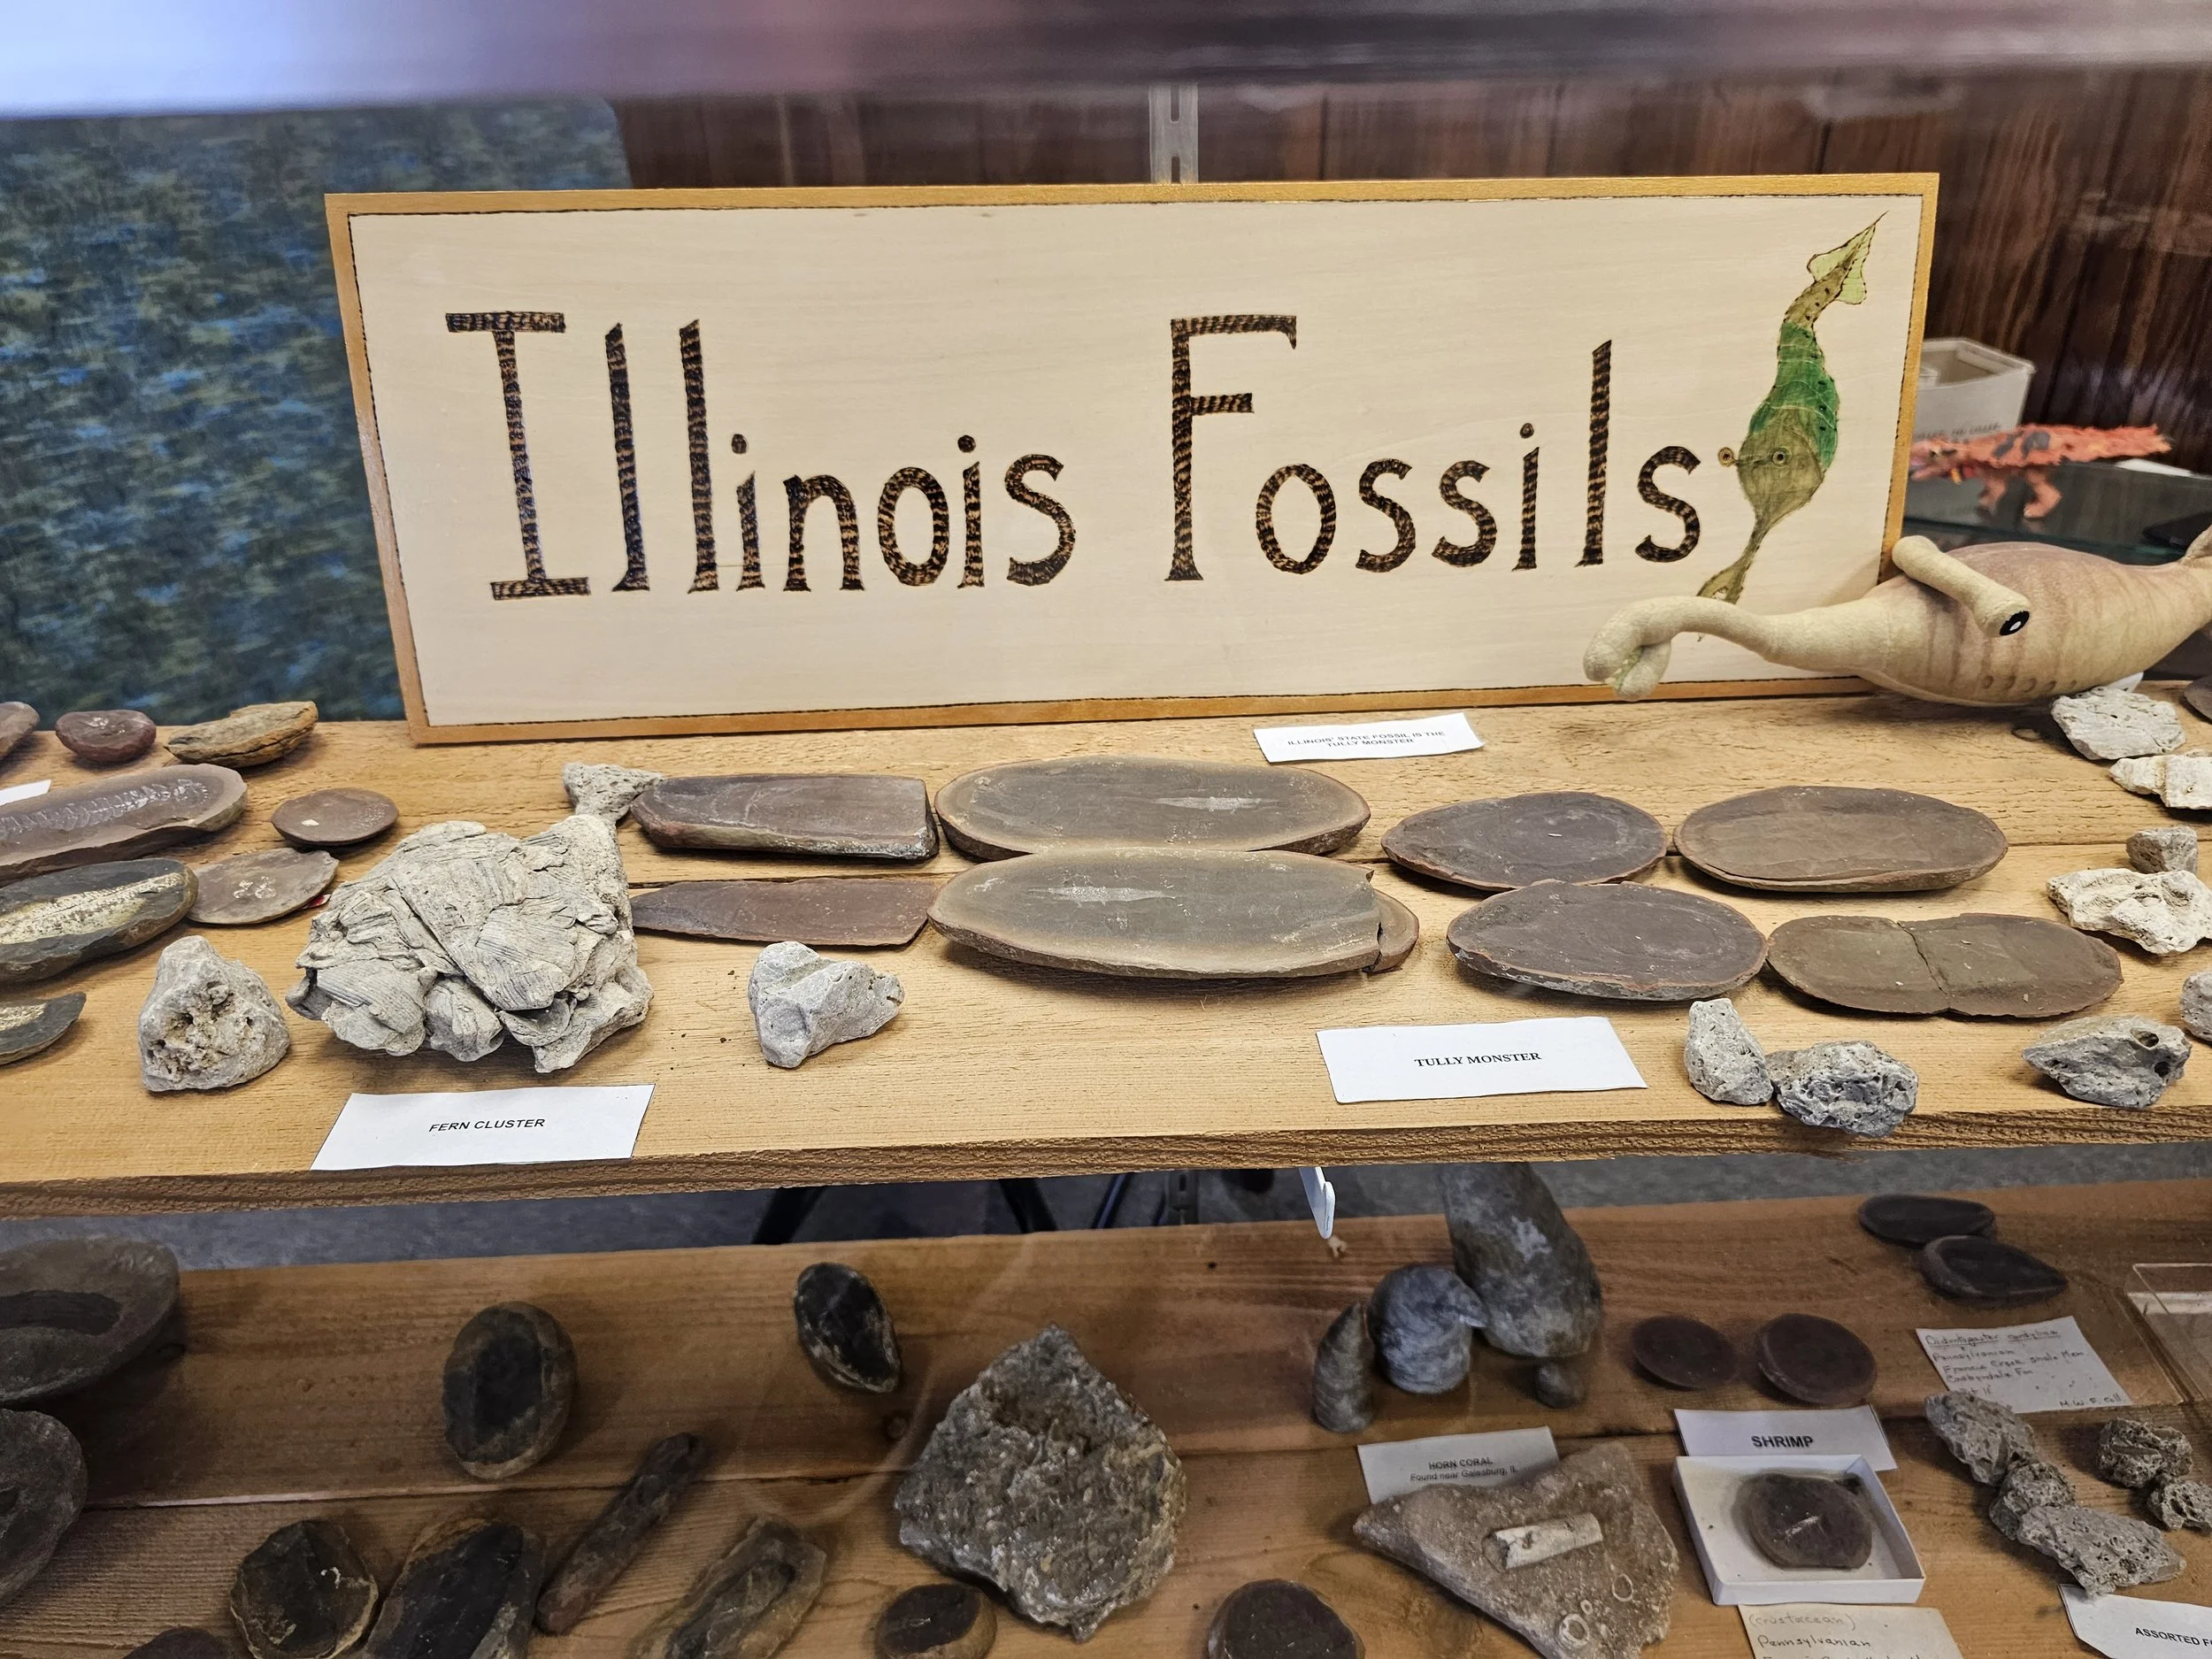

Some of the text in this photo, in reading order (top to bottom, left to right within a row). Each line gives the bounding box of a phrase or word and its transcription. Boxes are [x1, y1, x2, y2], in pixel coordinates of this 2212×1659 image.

[445, 311, 1701, 600] Illinois Fossils
[1414, 1052, 1542, 1067] TULLY MONSTER
[429, 1118, 546, 1133] FERN CLUSTER
[1750, 1435, 1813, 1448] SHRIMP
[1428, 1456, 1494, 1471] HORN CORAL
[1409, 1473, 1438, 1482] Found
[1757, 1634, 1871, 1648] Pennsylvanian
[2135, 1627, 2200, 1646] ASSORTED
